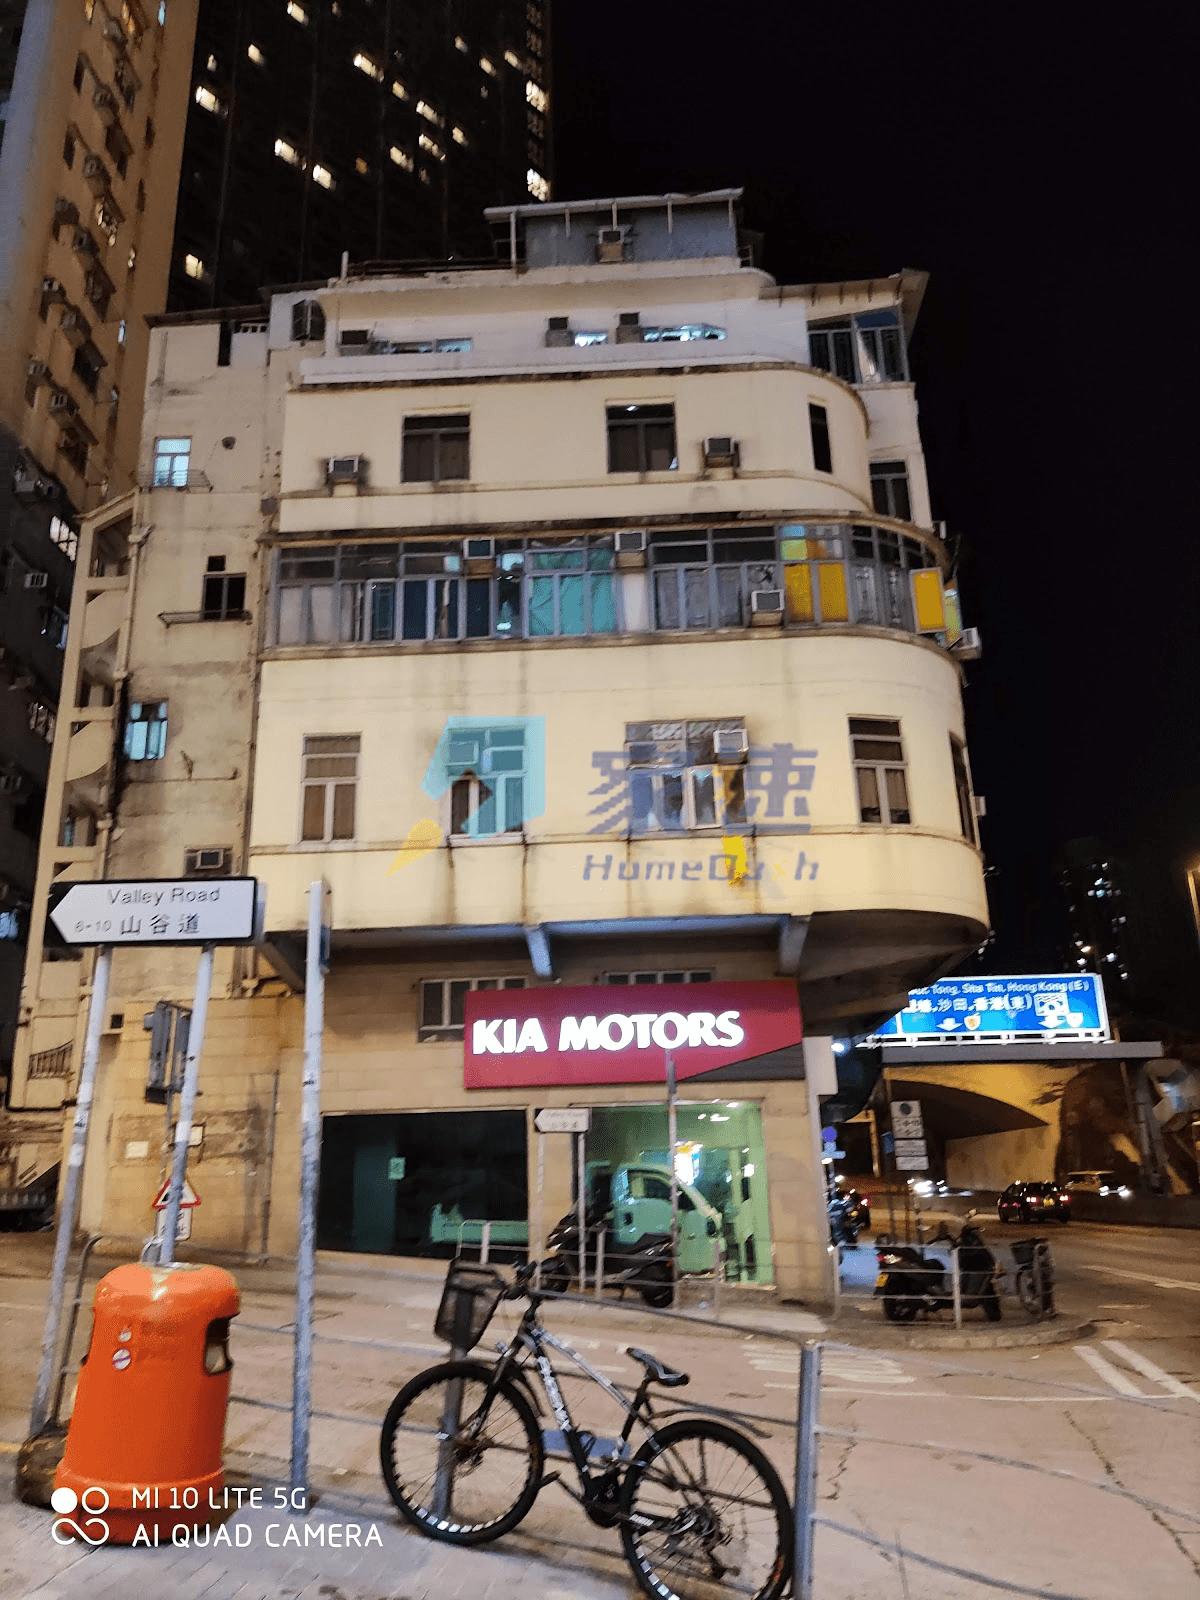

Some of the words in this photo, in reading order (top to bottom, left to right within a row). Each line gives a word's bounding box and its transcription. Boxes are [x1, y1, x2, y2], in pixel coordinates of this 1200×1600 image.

[107, 888, 165, 906] Valley
[171, 887, 221, 903] Road
[120, 913, 200, 935] 山谷道
[1007, 981, 1037, 993] Hong
[1037, 981, 1067, 993] Kong
[472, 1018, 548, 1055] KIA
[558, 1010, 745, 1051] MOTORS
